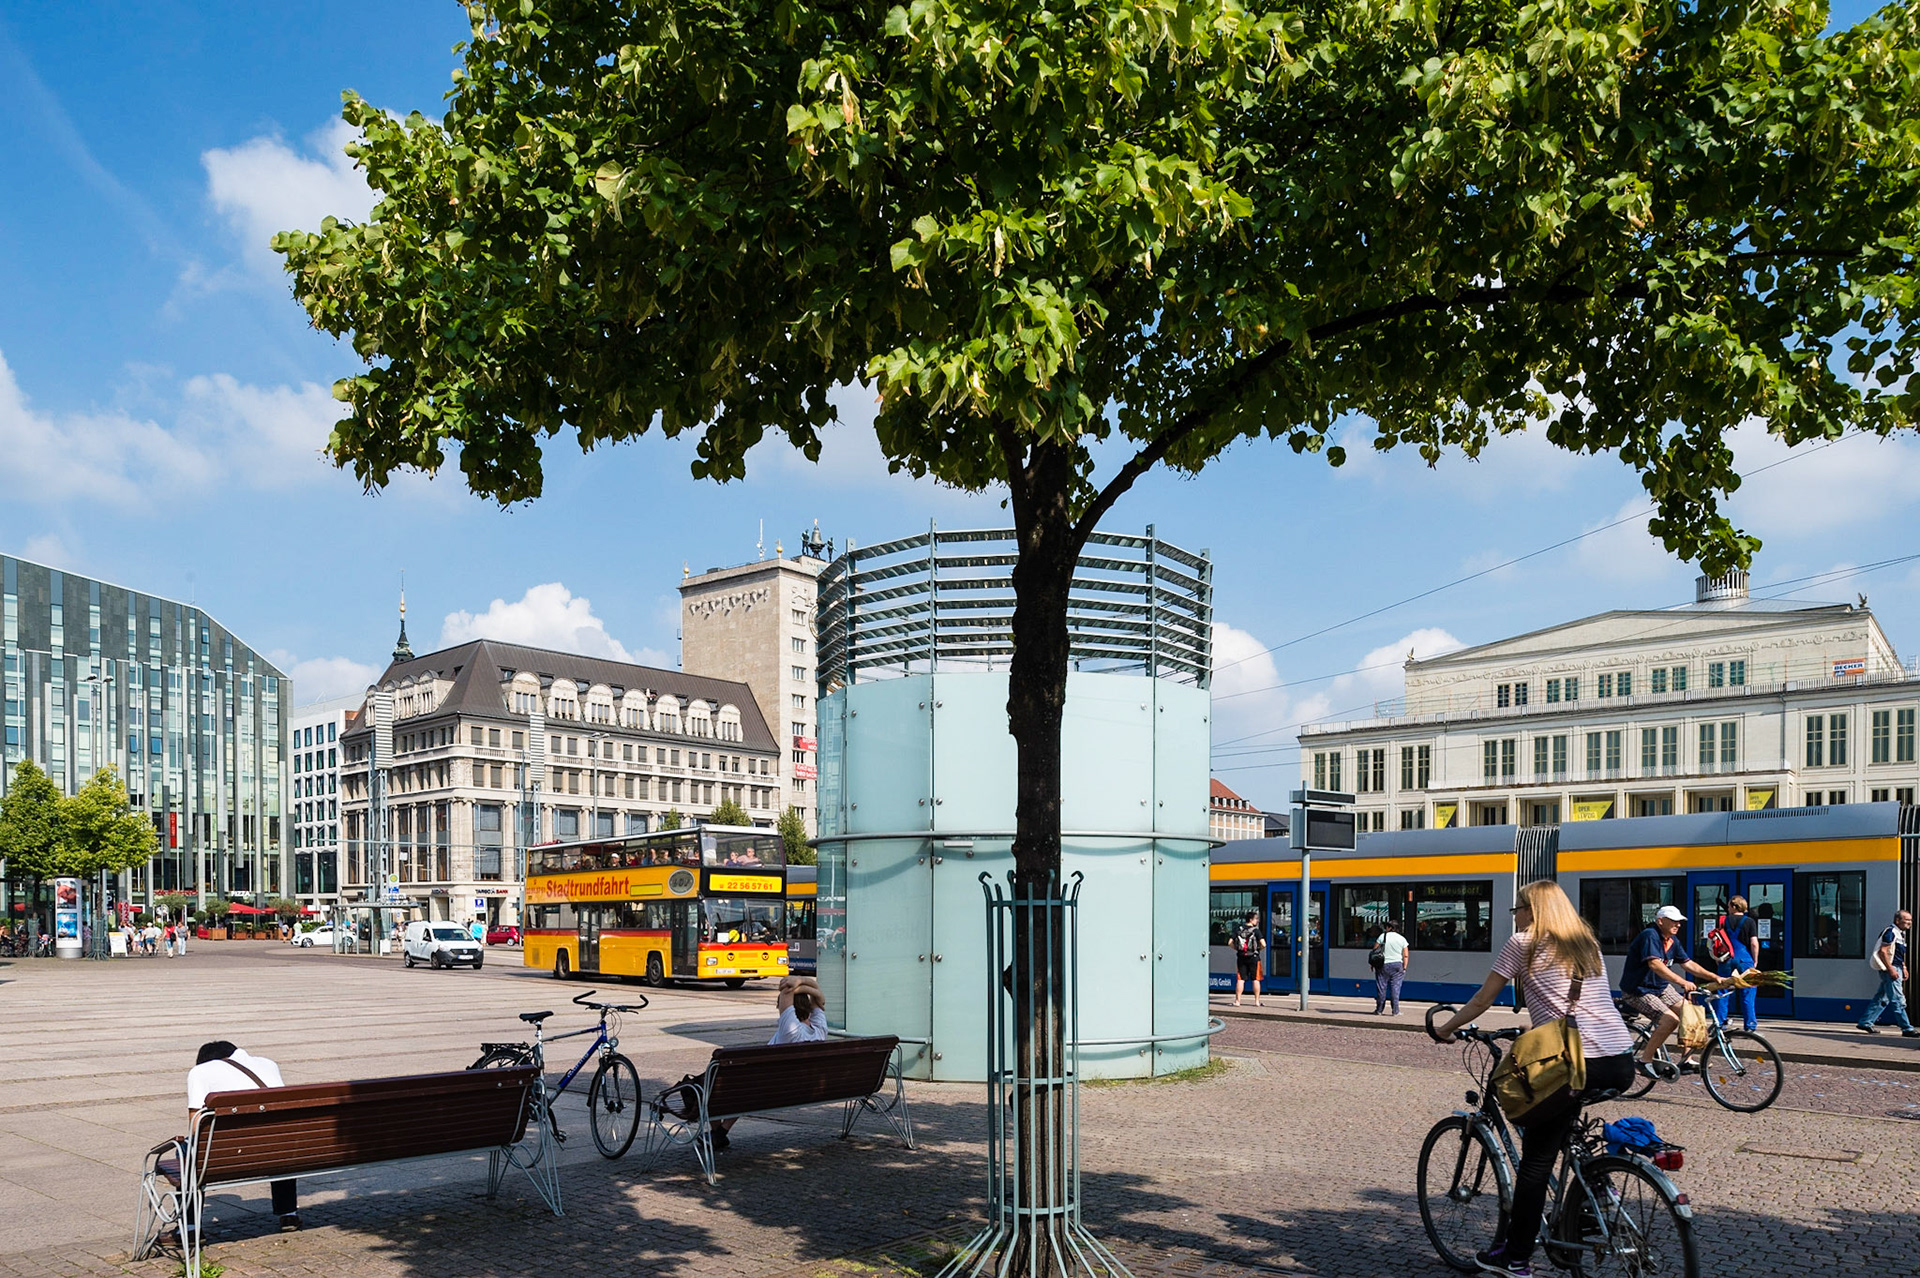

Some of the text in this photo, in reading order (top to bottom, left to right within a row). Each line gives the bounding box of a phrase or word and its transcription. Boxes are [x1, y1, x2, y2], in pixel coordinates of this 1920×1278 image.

[546, 876, 629, 898] Stadtrundfahrt
[752, 882, 762, 890] 57
[1427, 885, 1479, 895] 15 Meusdorf
[1219, 978, 1231, 986] GmbH
